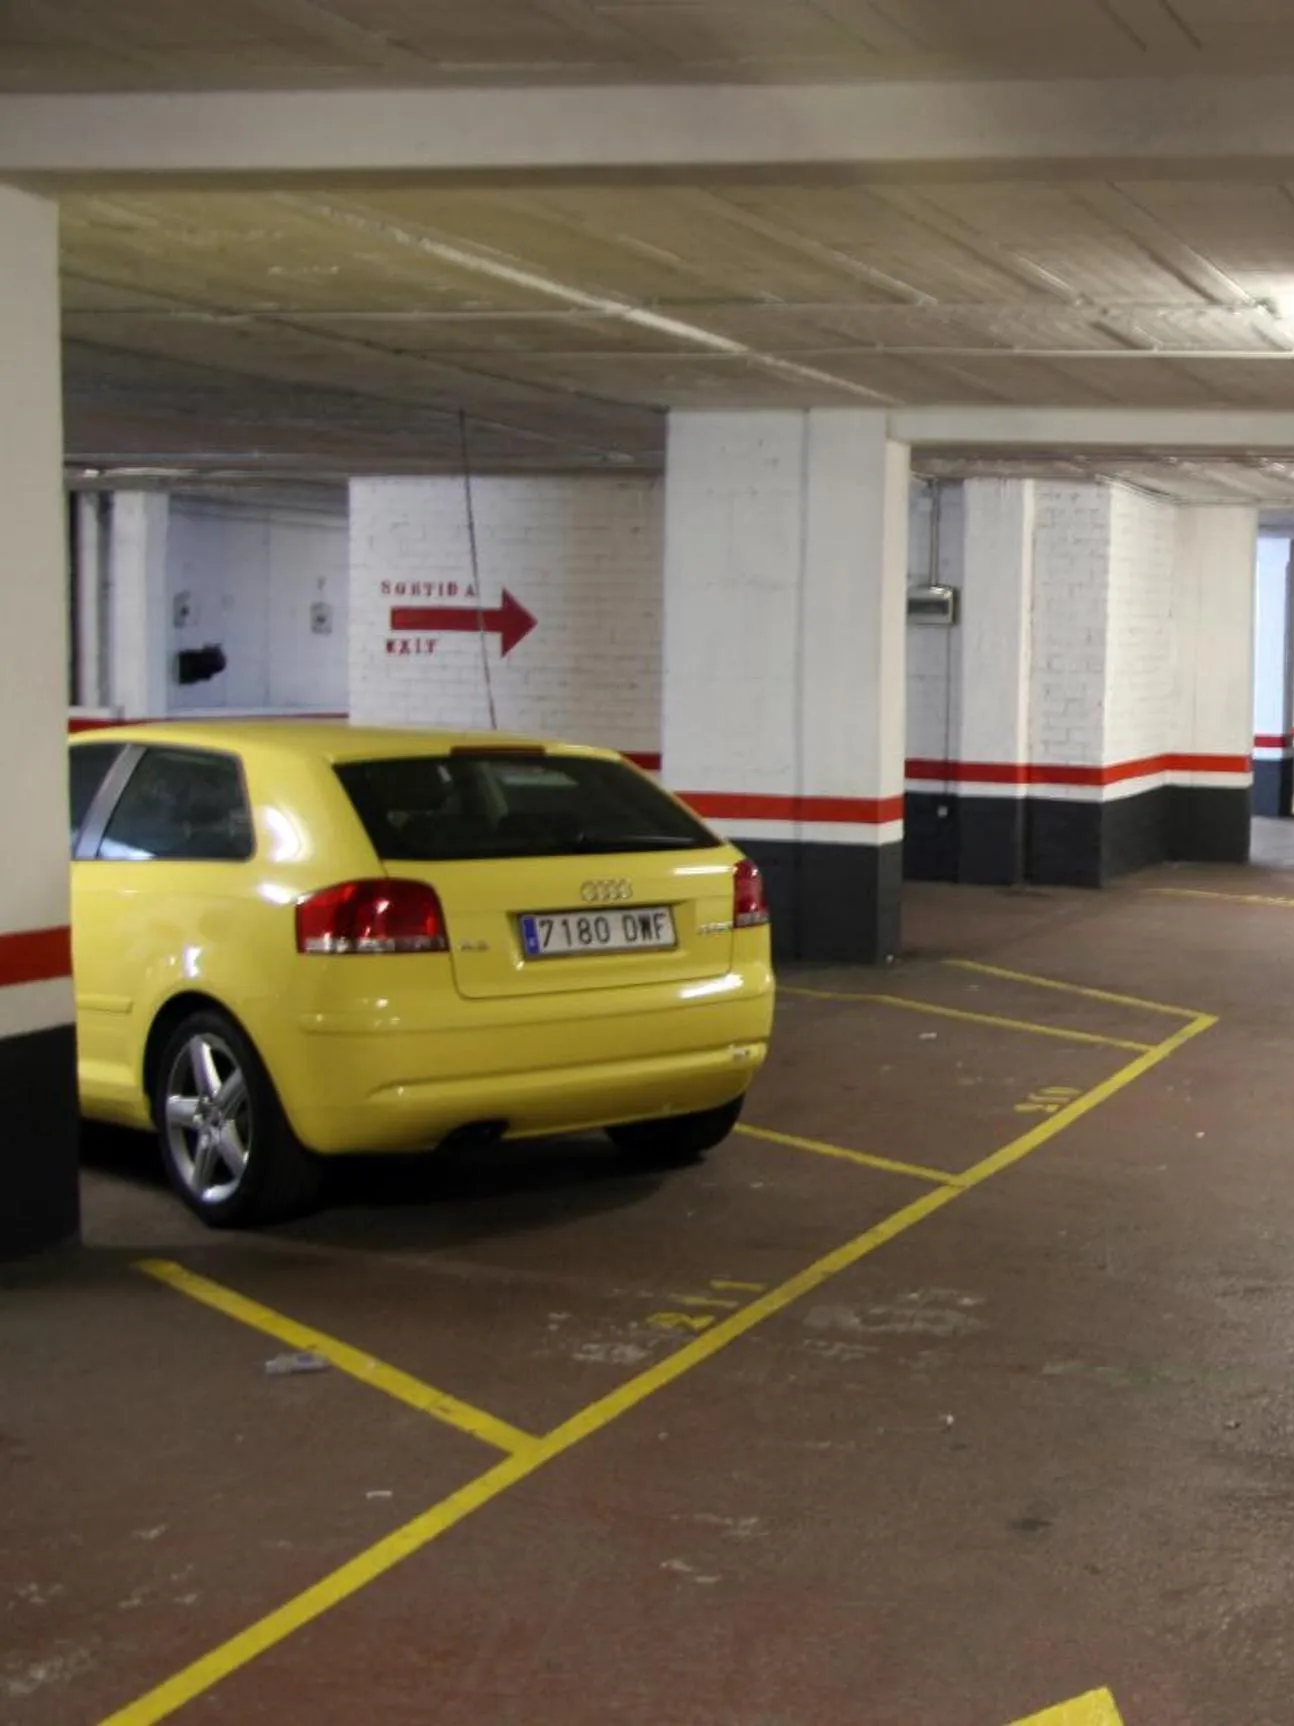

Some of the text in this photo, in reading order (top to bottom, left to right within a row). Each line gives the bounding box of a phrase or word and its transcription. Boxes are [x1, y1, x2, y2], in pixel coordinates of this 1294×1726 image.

[385, 638, 437, 655] EXIT
[538, 916, 611, 948] 7180
[622, 912, 667, 943] DWF
